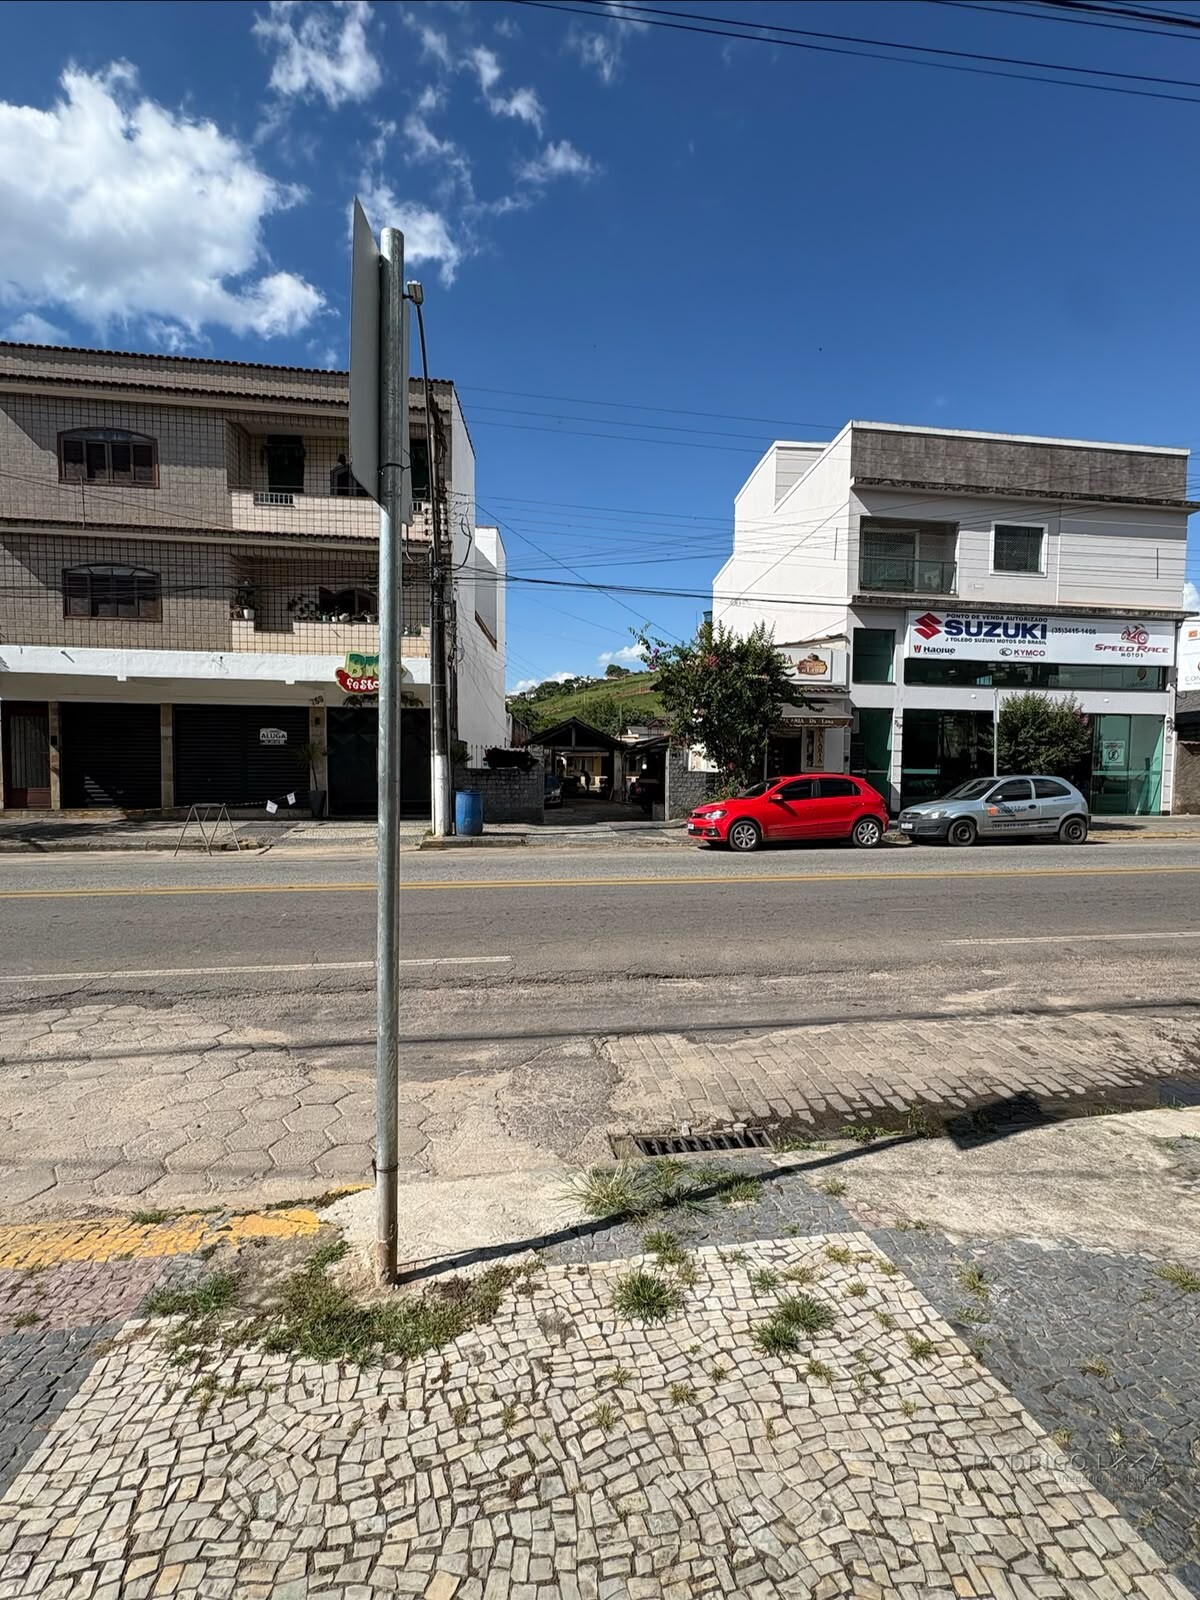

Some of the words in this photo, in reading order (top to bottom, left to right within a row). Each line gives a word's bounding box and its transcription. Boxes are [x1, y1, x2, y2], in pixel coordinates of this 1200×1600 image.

[1005, 615, 1048, 623] AUTORIZADO
[944, 619, 1047, 640] SUZUKI
[1013, 649, 1046, 657] KYMCO
[1094, 643, 1135, 653] SPEED
[1136, 645, 1170, 654] RACE
